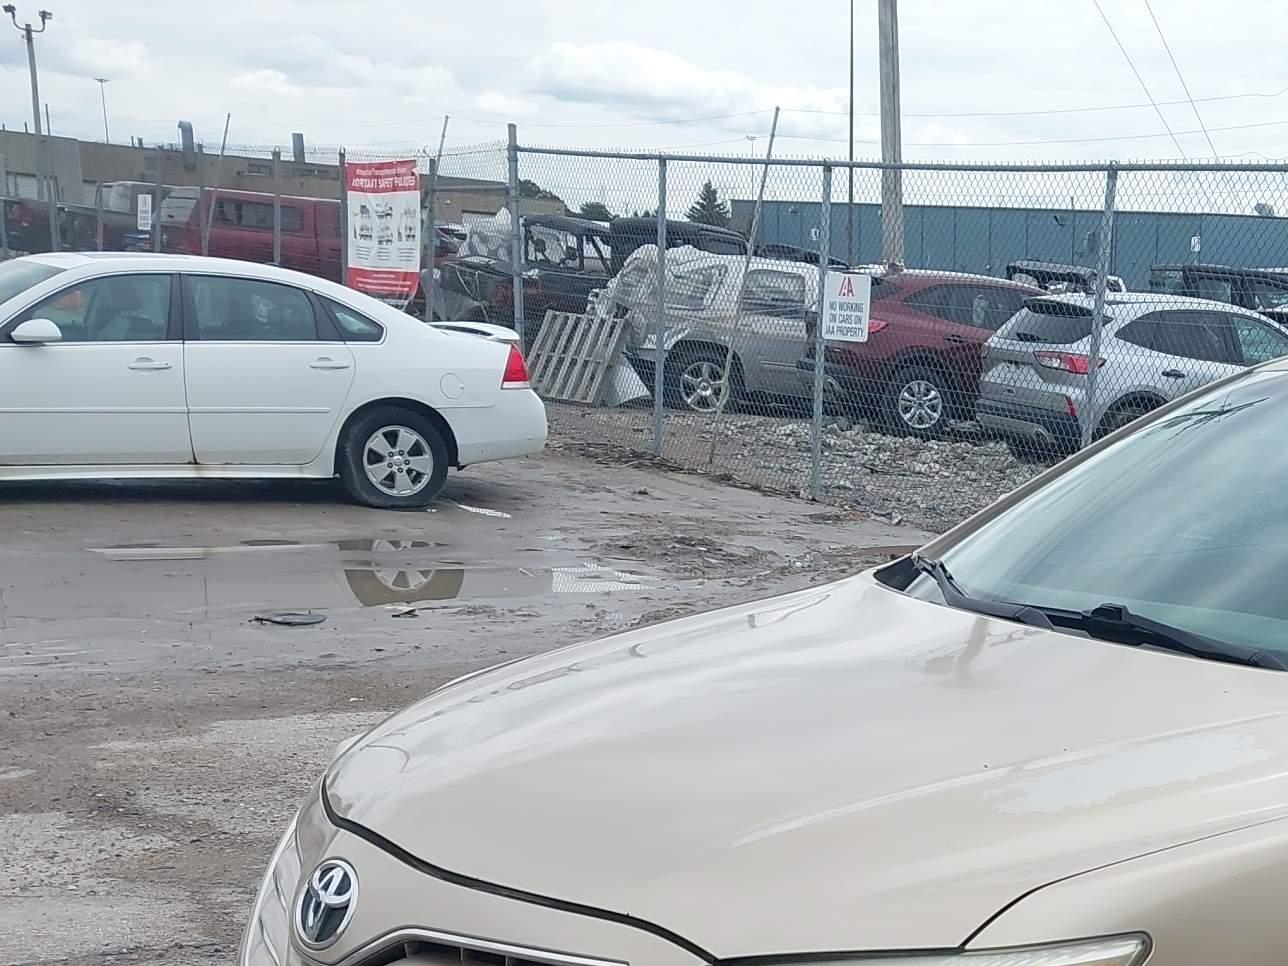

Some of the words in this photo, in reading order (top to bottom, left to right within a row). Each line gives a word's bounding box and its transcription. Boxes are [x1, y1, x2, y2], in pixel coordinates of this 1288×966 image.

[829, 301, 838, 312] NO
[838, 302, 864, 313] WORKING
[829, 313, 837, 323] ON
[838, 313, 853, 324] CARS
[854, 315, 863, 325] ON
[825, 325, 835, 335] IAA
[836, 325, 864, 337] PROPERTY
